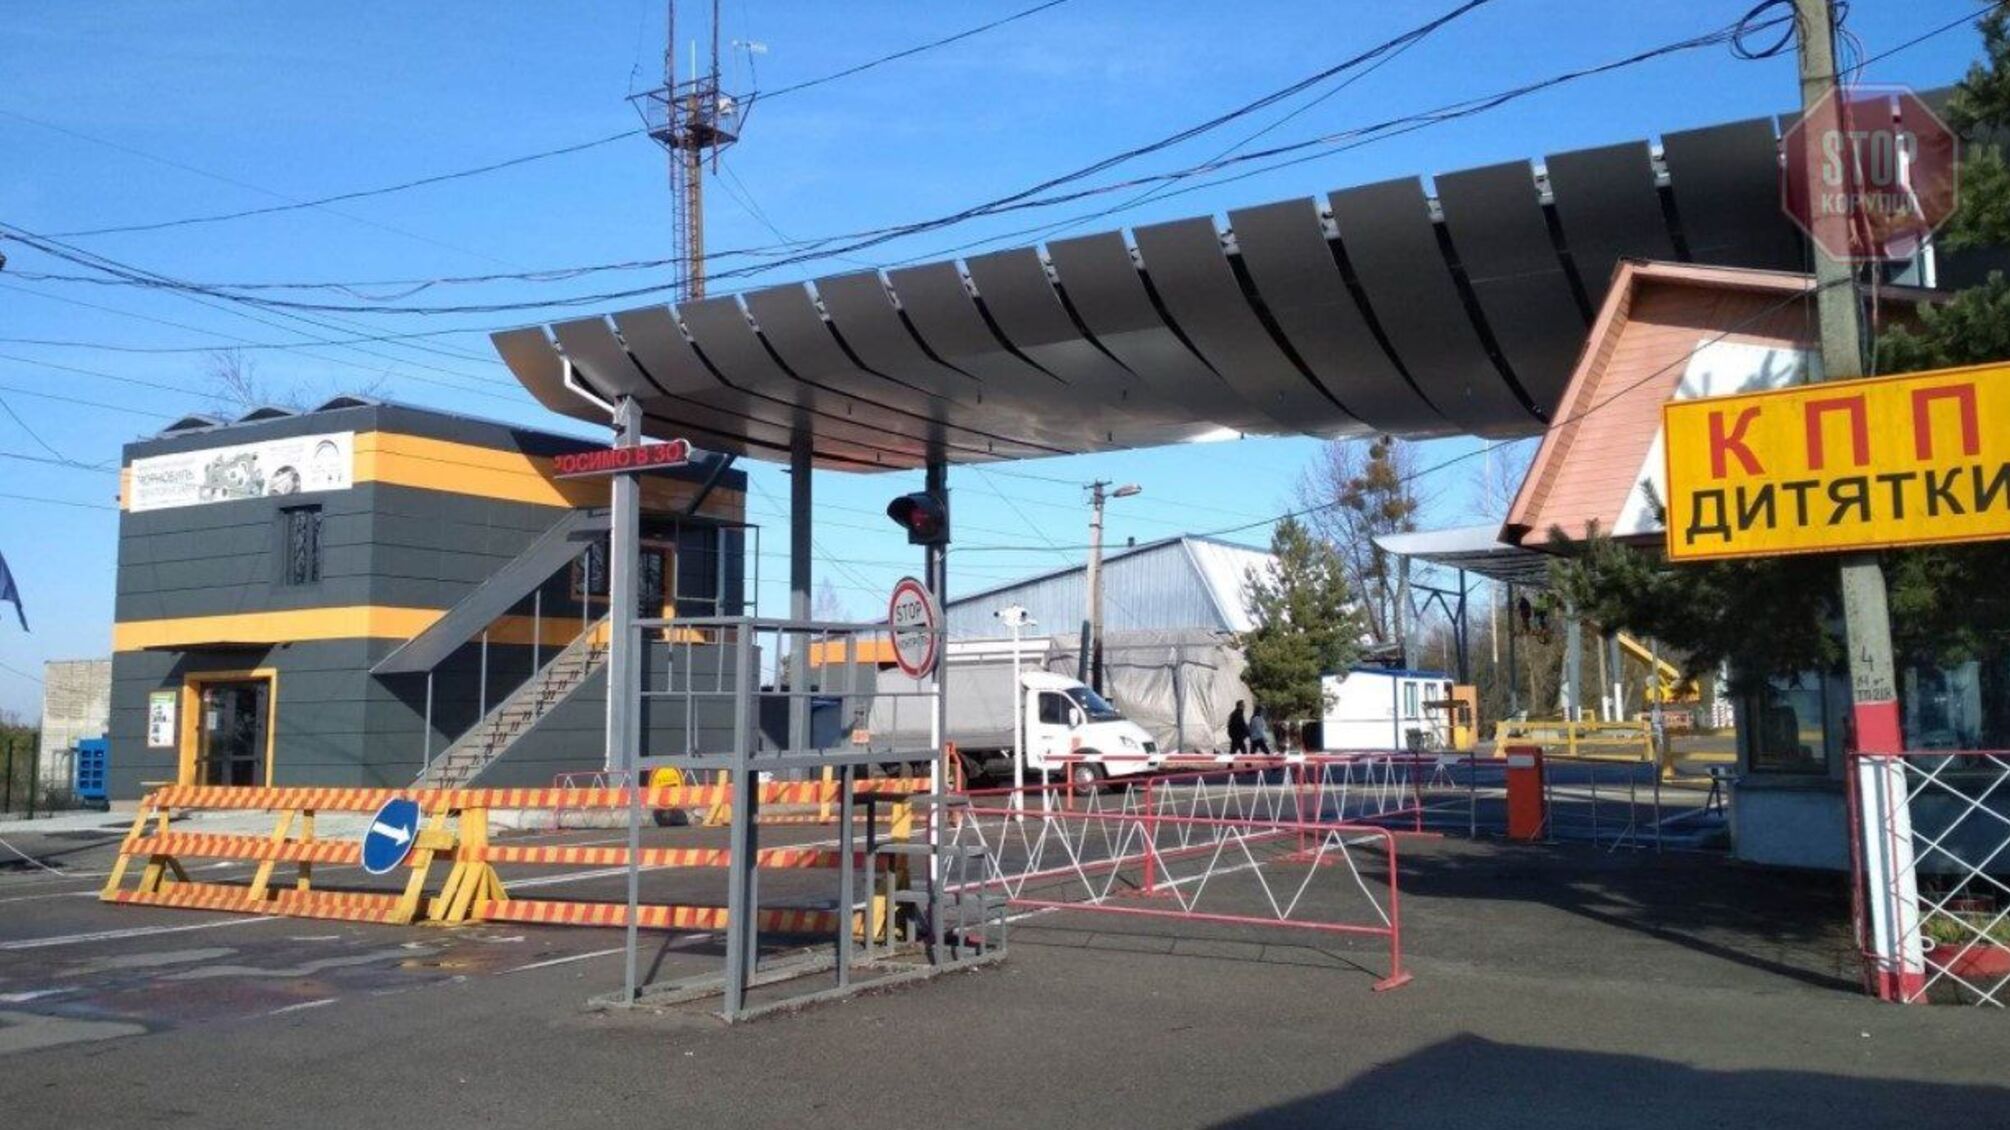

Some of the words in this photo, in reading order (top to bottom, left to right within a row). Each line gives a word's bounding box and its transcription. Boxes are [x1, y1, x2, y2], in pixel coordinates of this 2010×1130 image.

[636, 447, 648, 465] В
[1686, 461, 2010, 545] ДИТЯТКИ
[896, 601, 922, 622] STOP
[1861, 645, 1874, 672] 4
